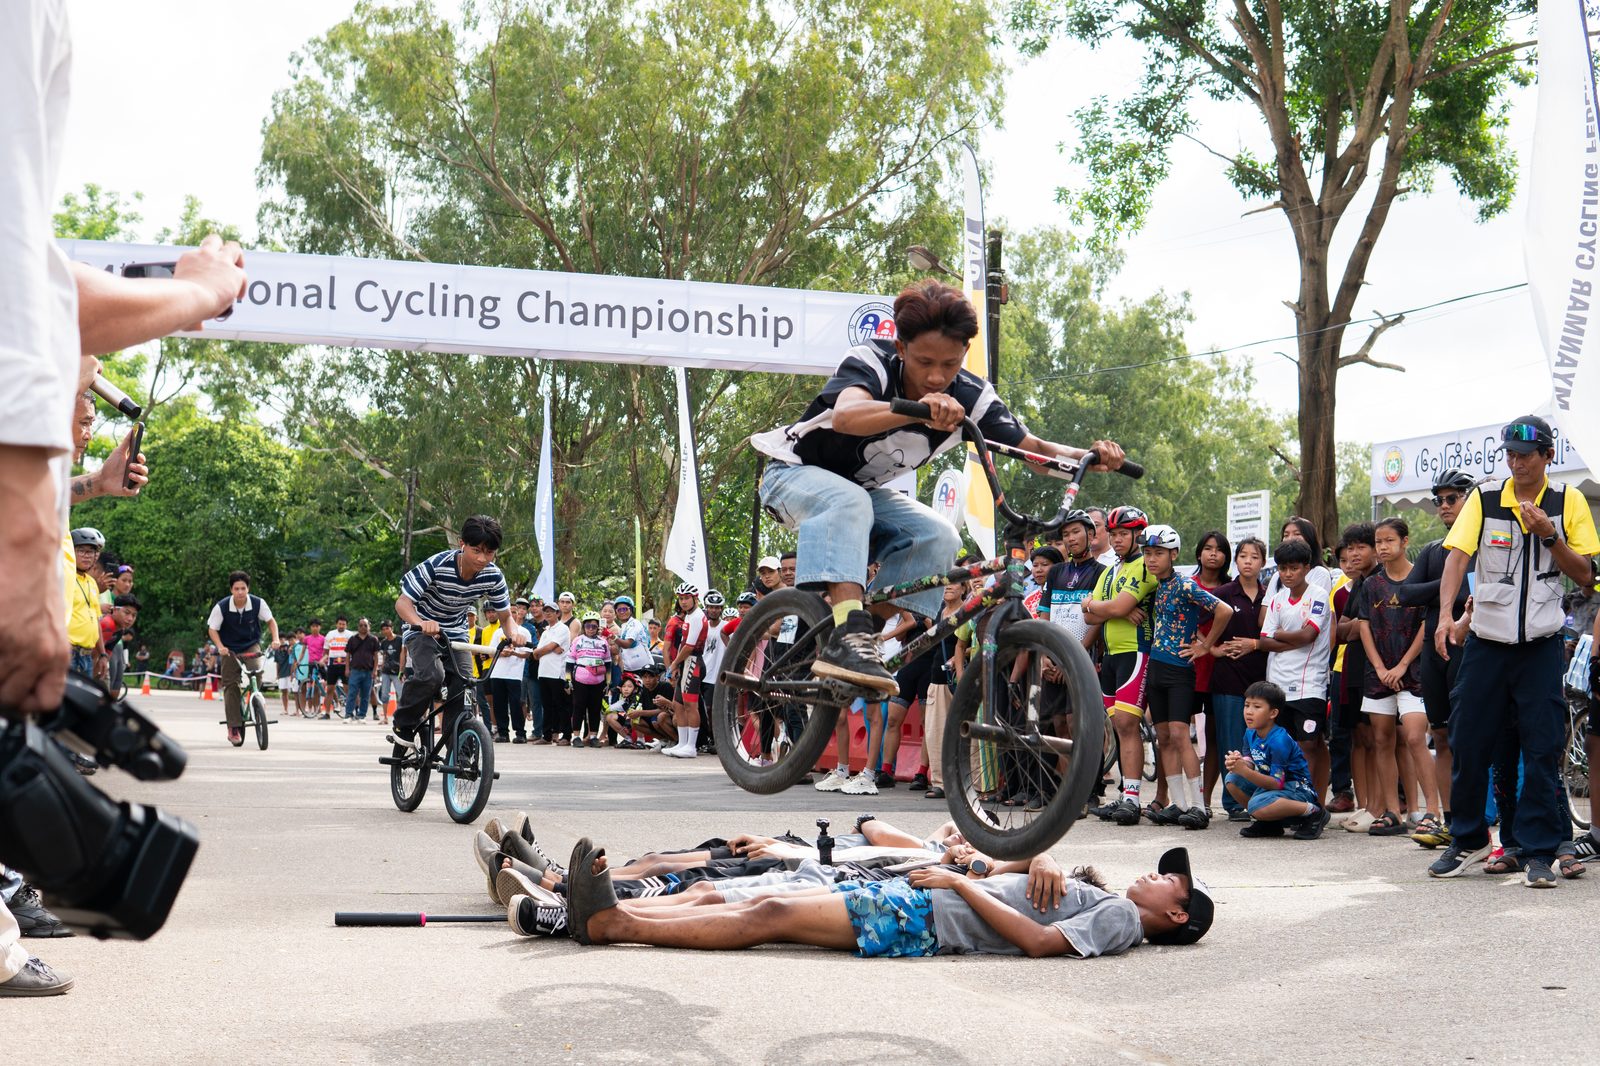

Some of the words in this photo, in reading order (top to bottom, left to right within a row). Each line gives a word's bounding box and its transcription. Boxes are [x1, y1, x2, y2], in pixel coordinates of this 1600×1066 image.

[237, 275, 337, 310] onal
[354, 279, 502, 330] Cycling
[516, 290, 795, 348] Championship
